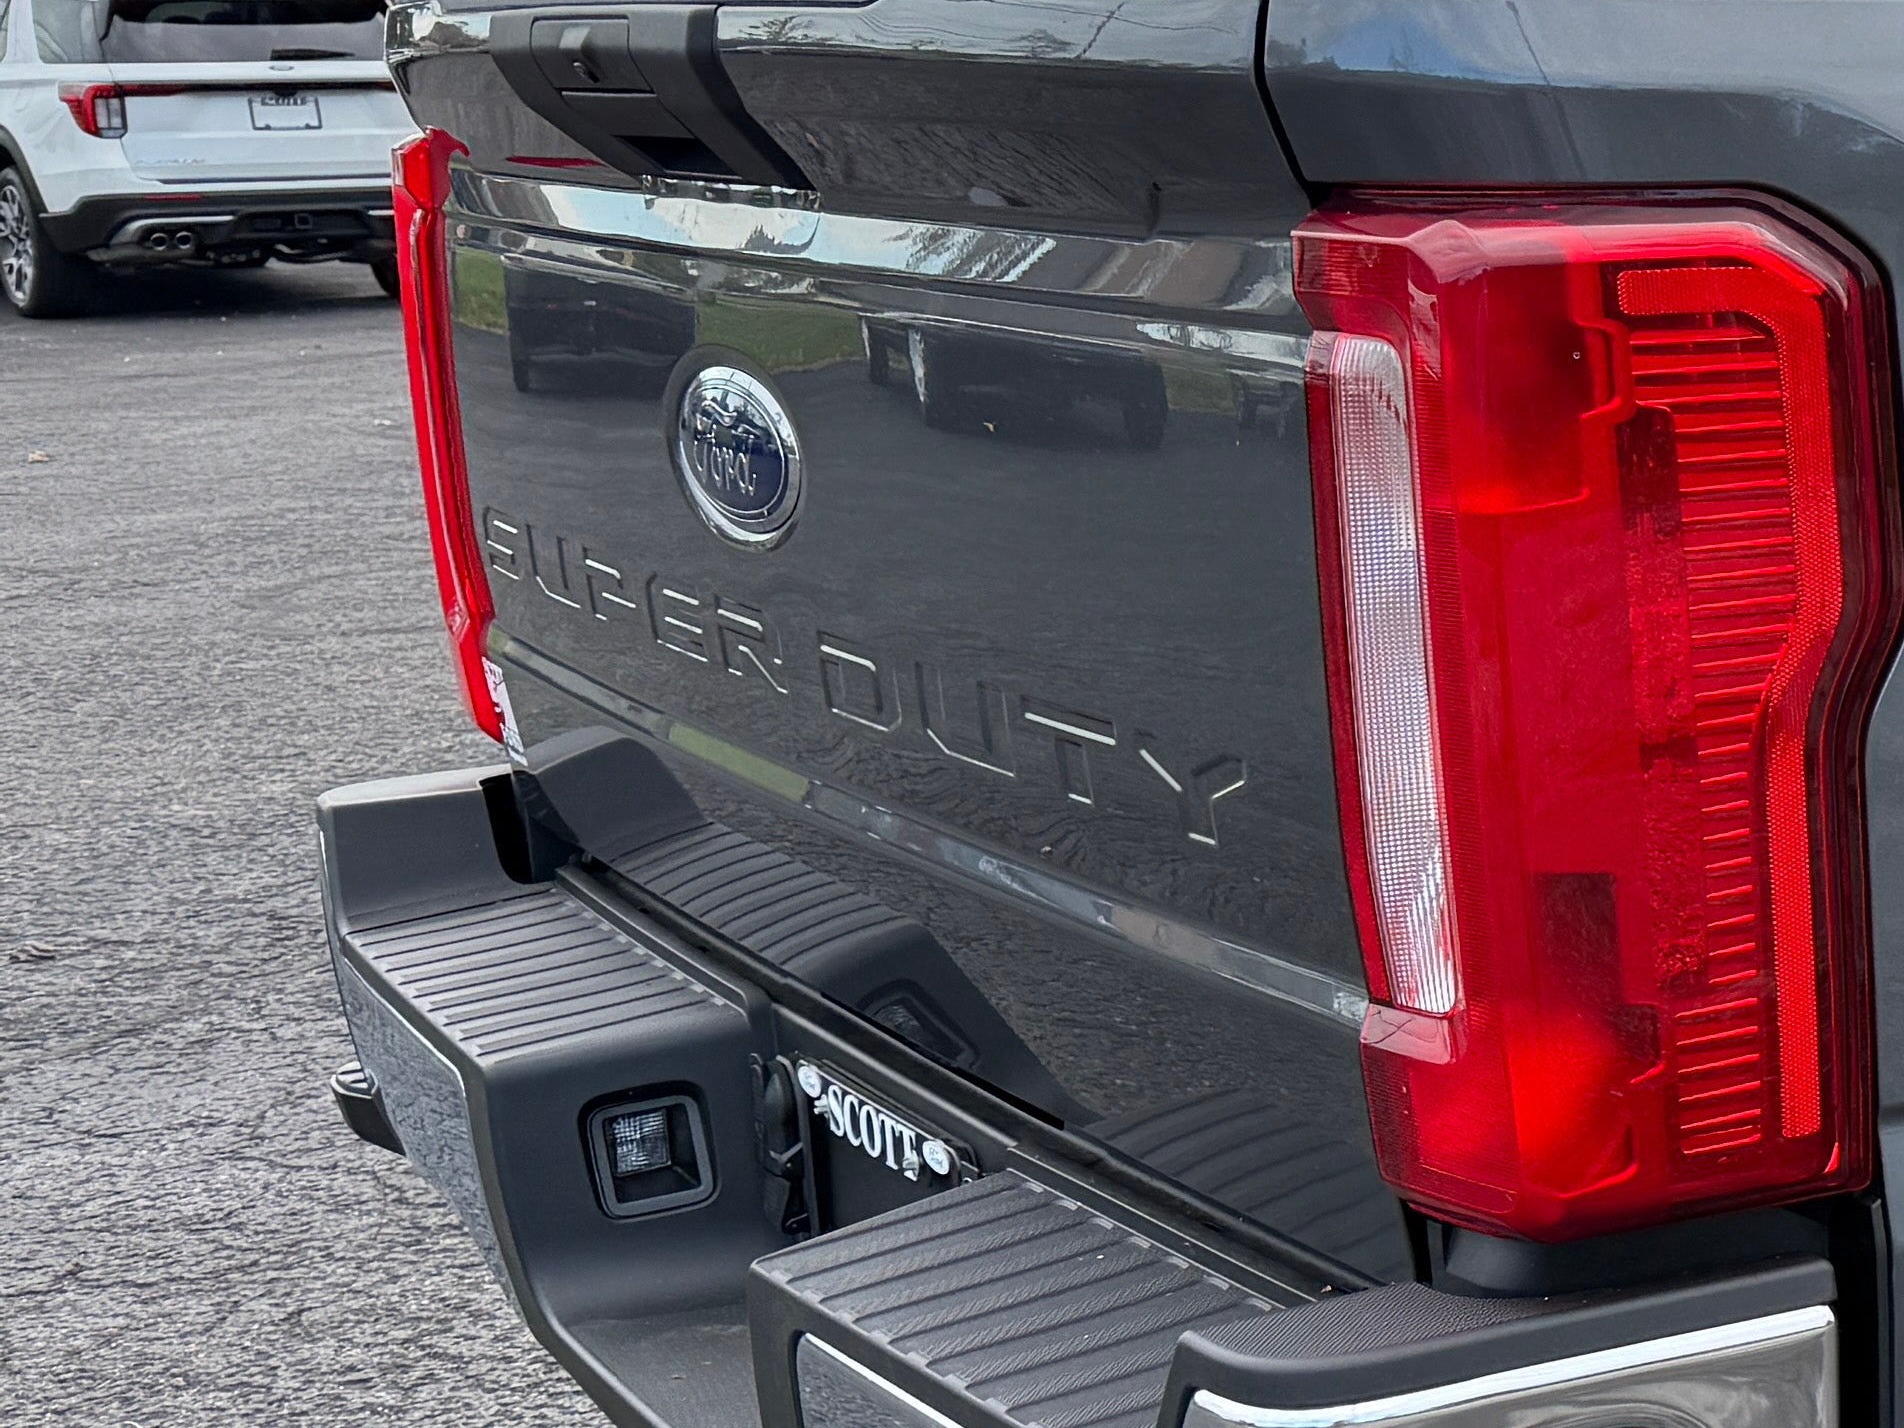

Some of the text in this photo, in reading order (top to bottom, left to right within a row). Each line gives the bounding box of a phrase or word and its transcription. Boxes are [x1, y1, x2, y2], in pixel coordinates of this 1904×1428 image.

[482, 505, 1248, 847] SUPER DUTY
[827, 1084, 919, 1182] SCOTT
